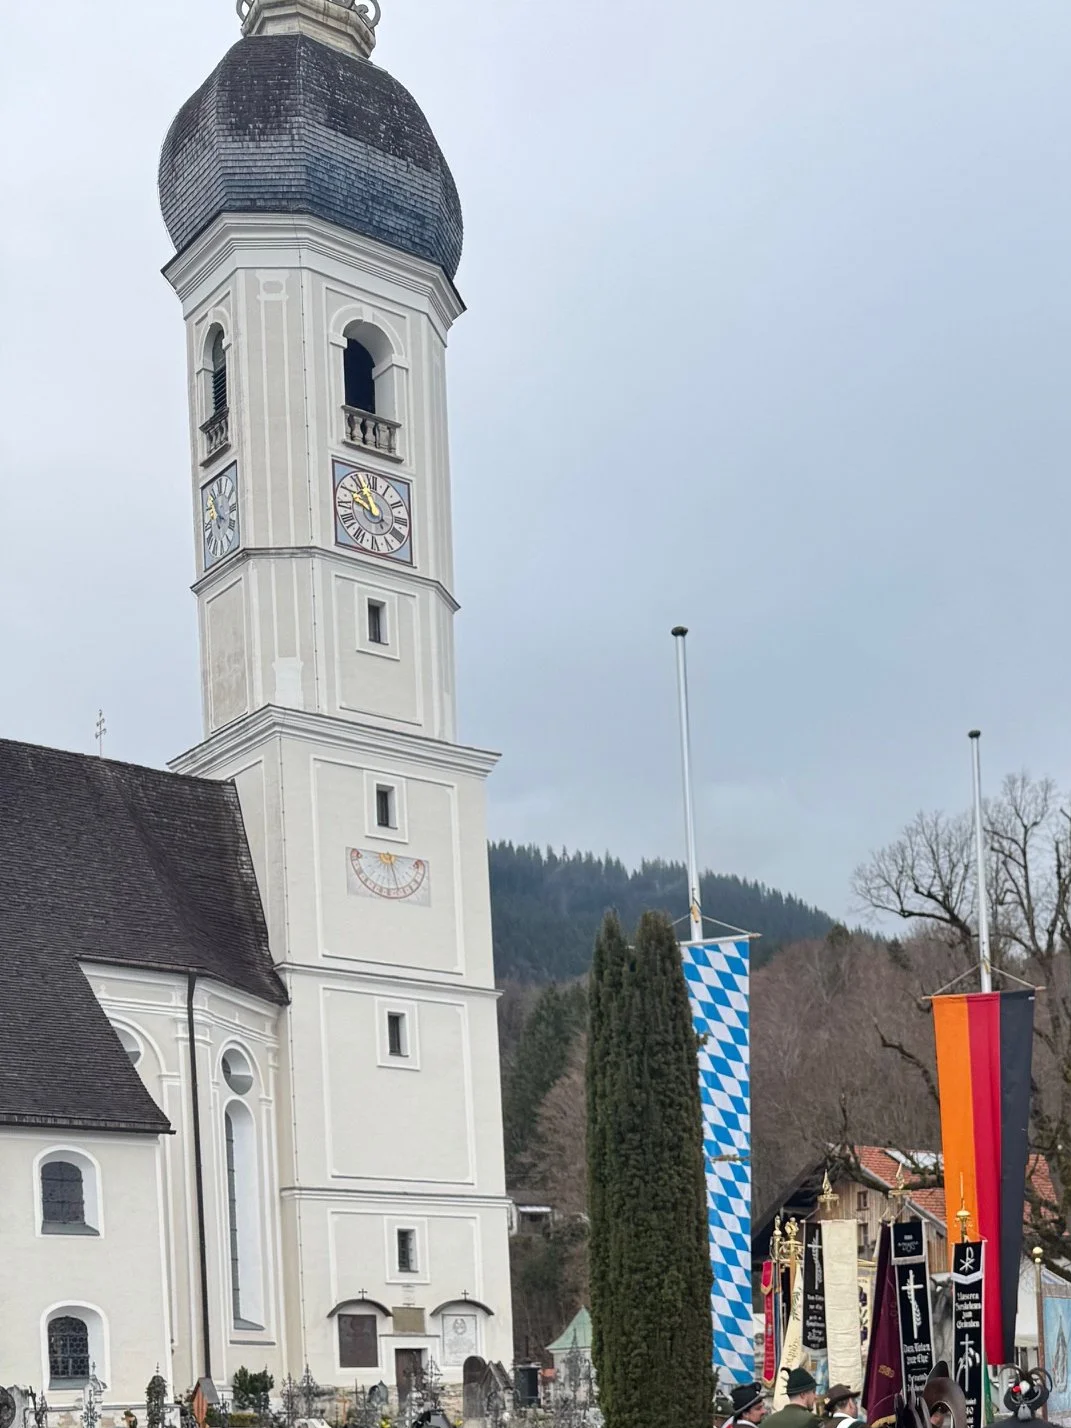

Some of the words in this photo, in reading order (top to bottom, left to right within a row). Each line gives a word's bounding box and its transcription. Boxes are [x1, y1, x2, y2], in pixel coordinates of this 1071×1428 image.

[382, 485, 390, 497] I
[390, 500, 403, 509] II
[394, 516, 408, 527] III
[353, 526, 366, 544] VII
